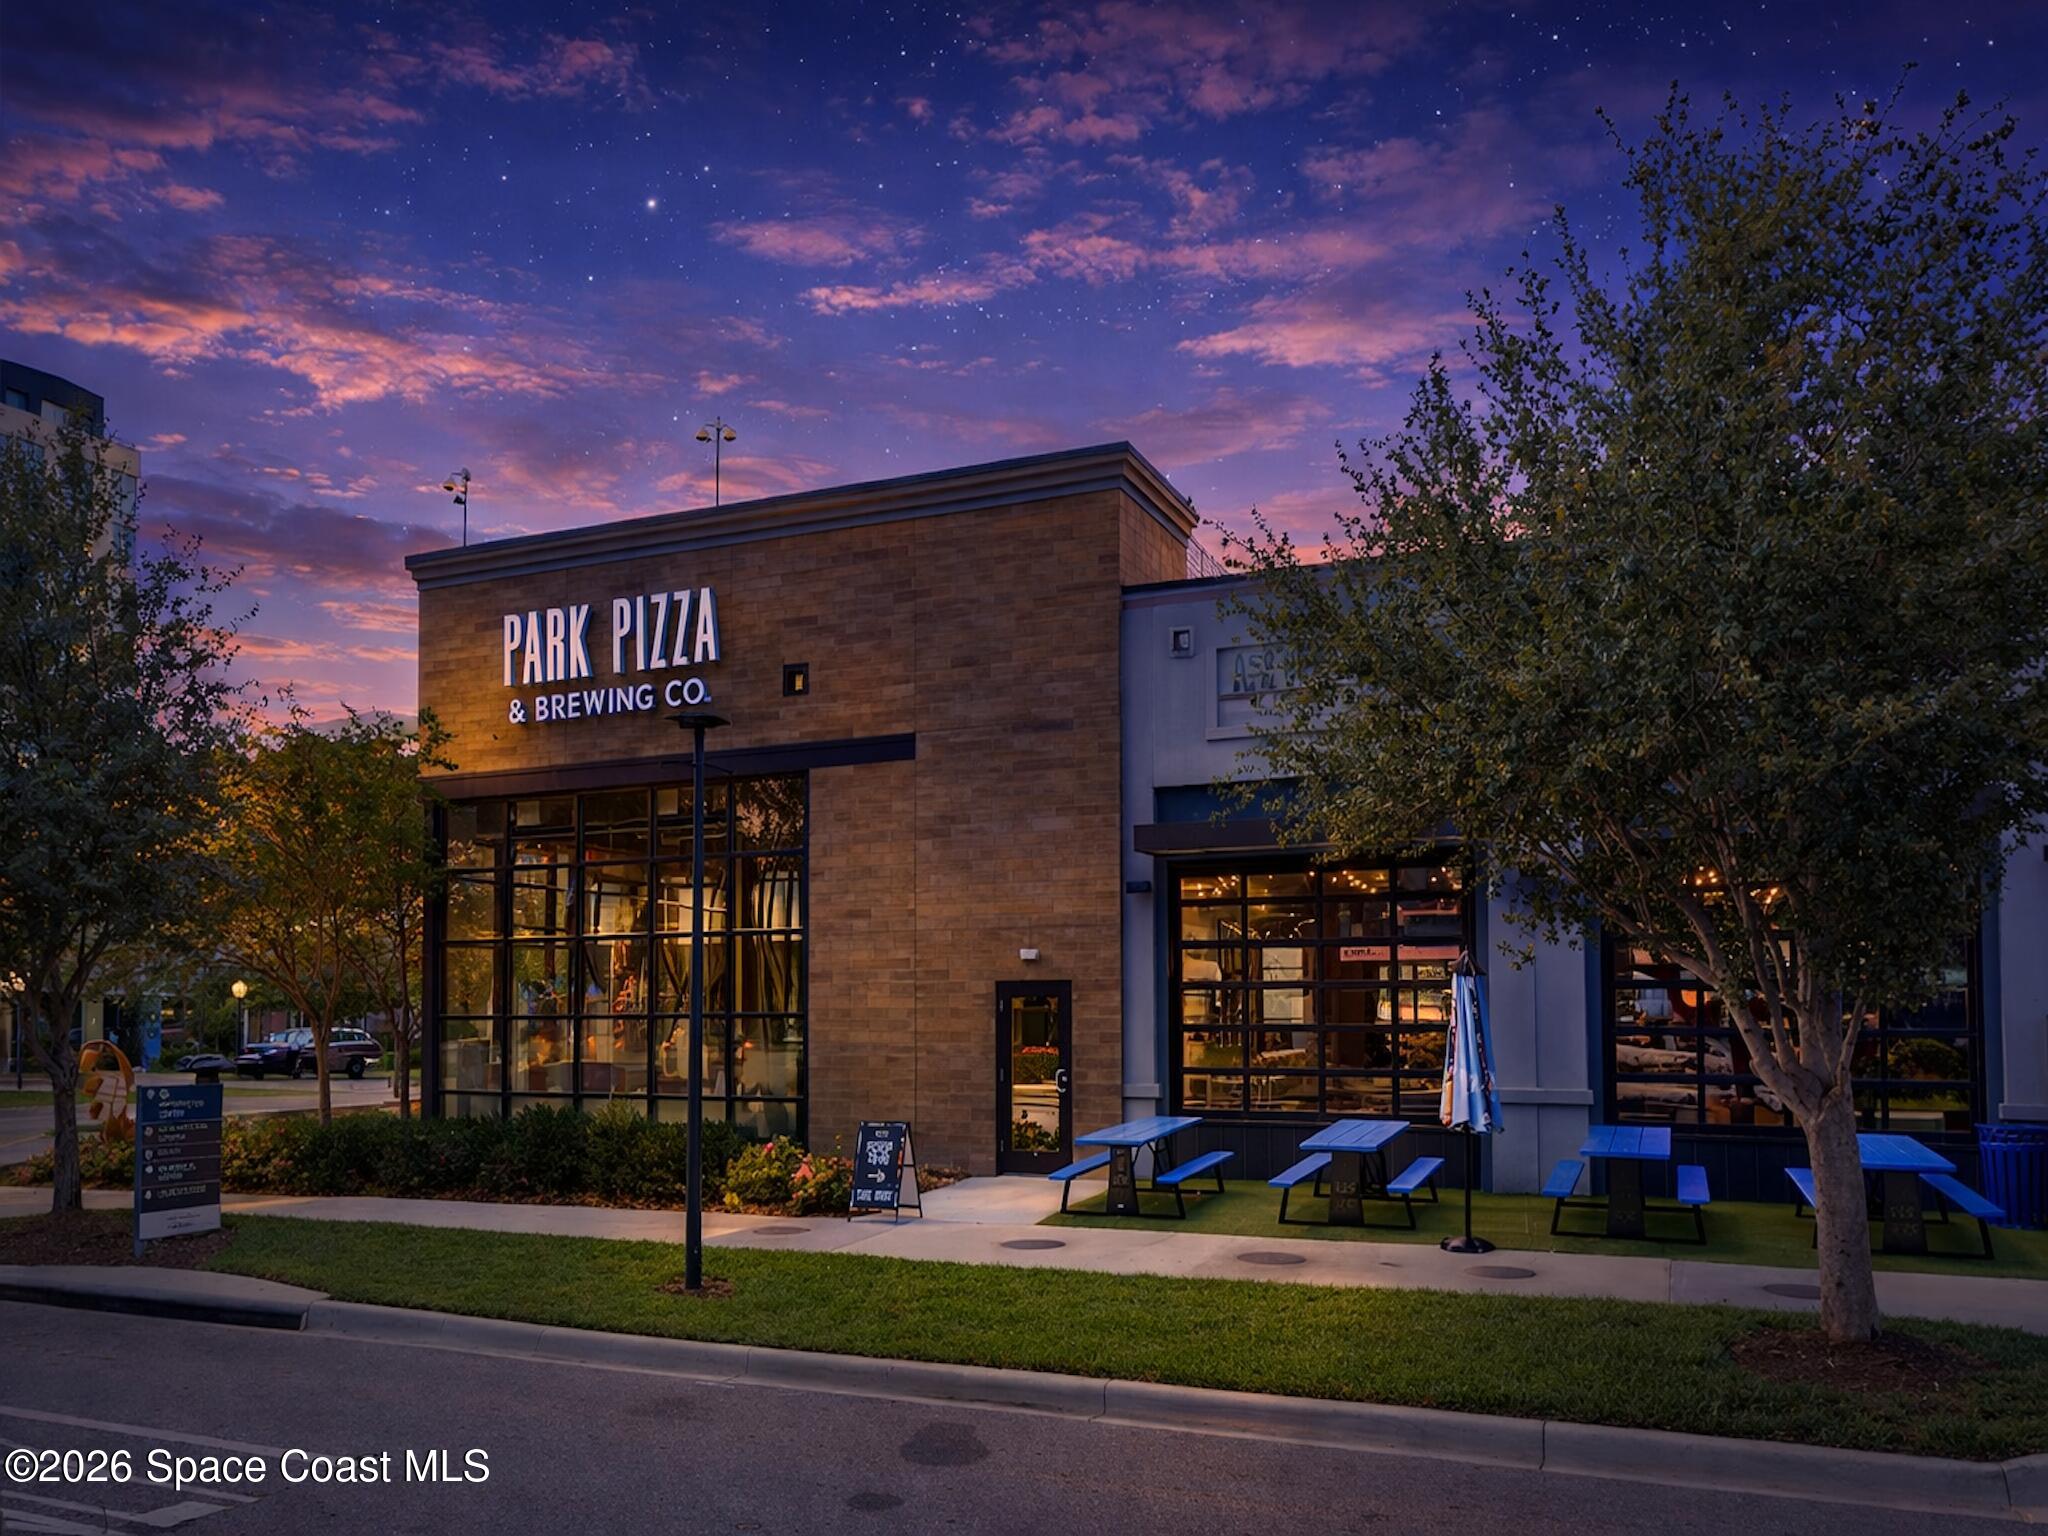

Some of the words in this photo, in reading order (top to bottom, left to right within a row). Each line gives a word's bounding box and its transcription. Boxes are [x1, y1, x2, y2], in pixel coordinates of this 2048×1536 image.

[503, 604, 592, 686] PARK
[612, 587, 719, 674] PIZZA
[509, 699, 526, 724] &
[535, 684, 655, 722] BREWING
[665, 677, 712, 707] CO.
